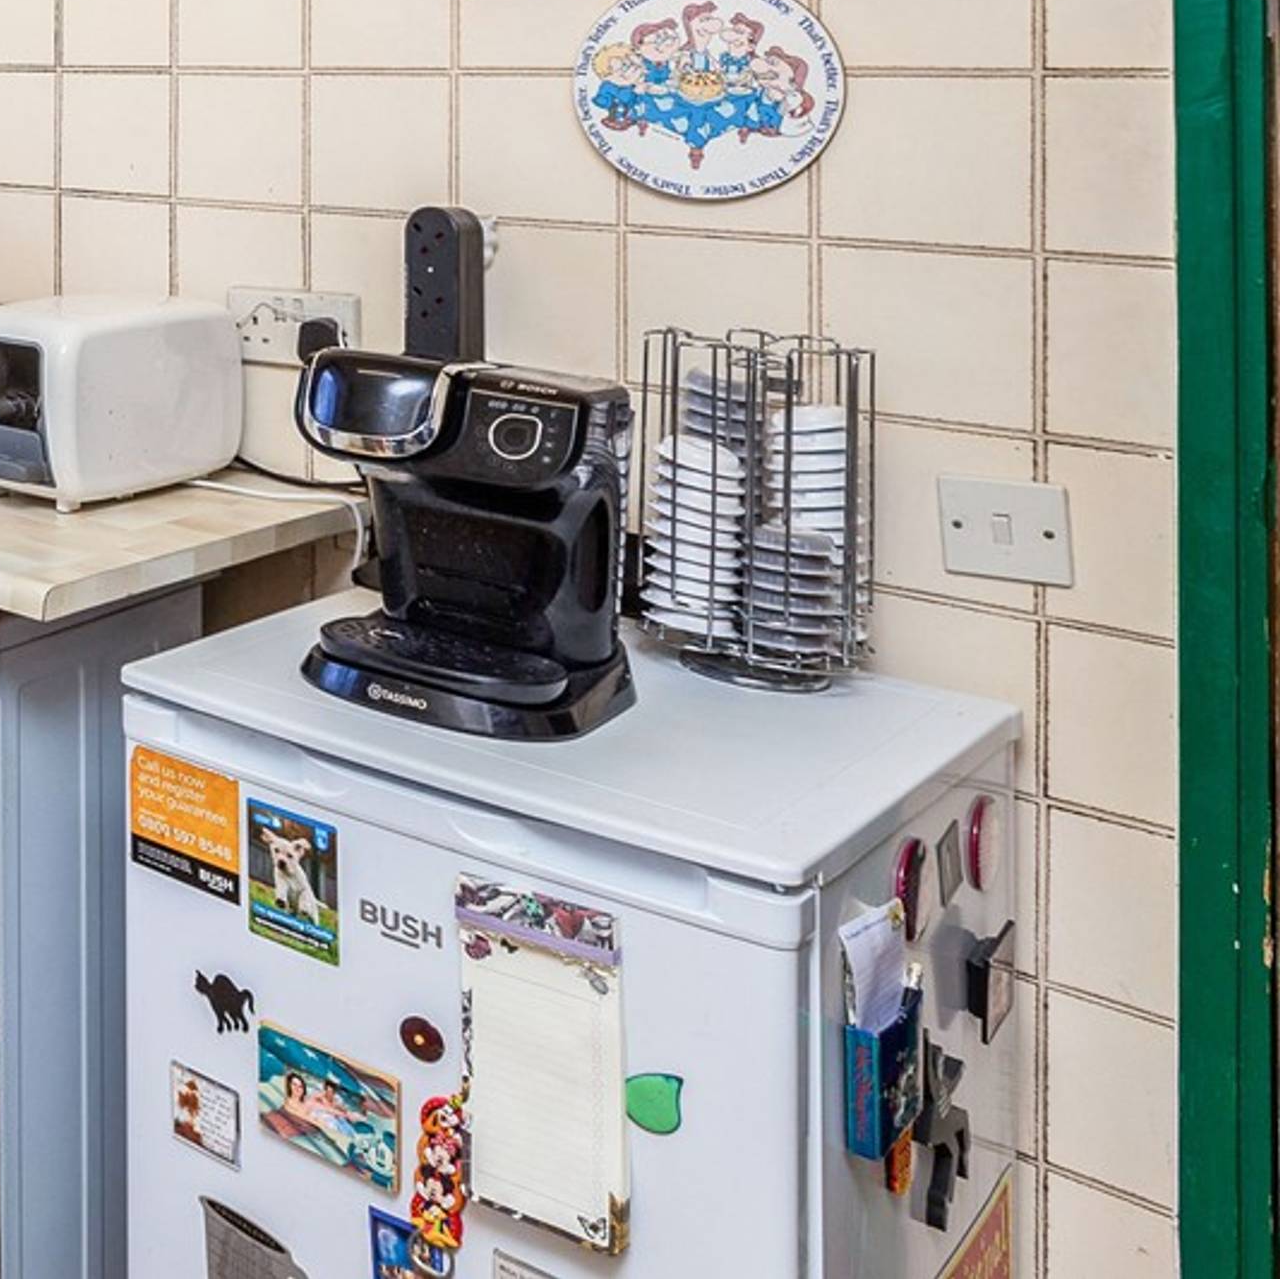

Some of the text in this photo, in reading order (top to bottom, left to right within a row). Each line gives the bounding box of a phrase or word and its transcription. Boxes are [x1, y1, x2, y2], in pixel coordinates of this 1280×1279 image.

[137, 755, 206, 789] Call us now
[137, 786, 165, 803] your
[198, 868, 234, 894] BUSH
[360, 898, 443, 949] BUSH
